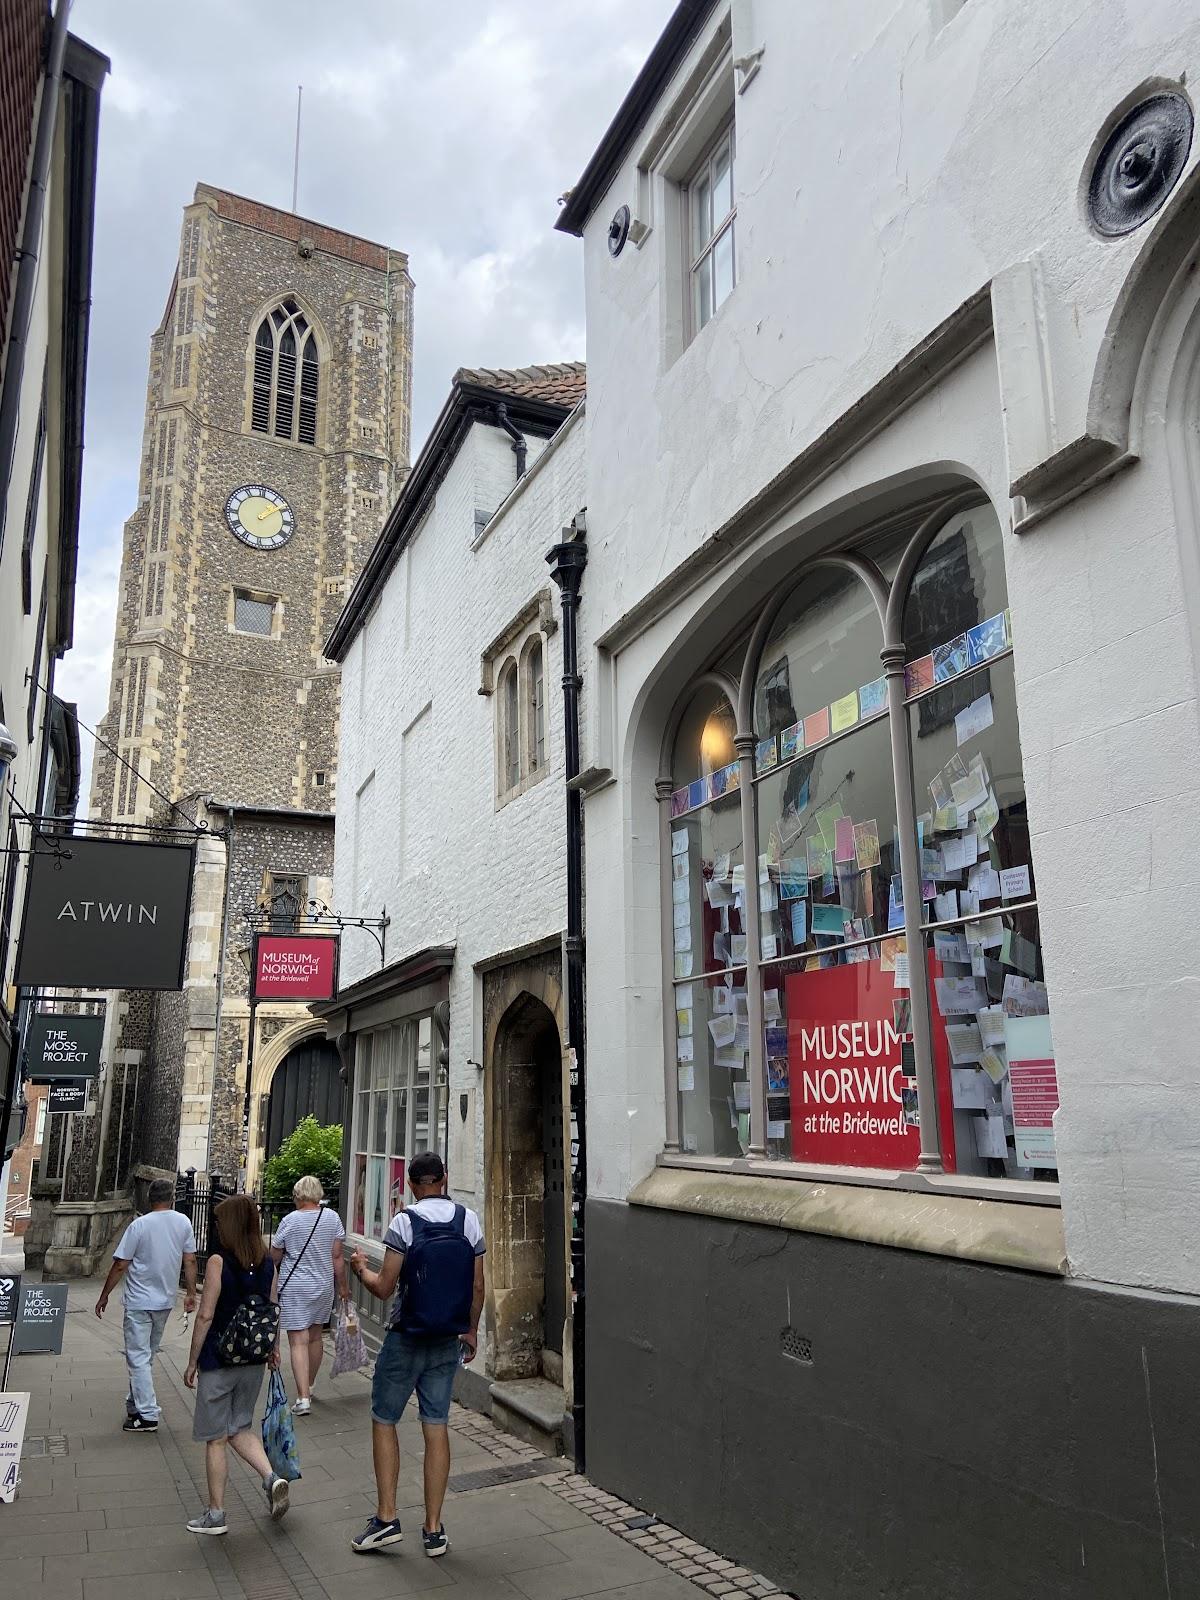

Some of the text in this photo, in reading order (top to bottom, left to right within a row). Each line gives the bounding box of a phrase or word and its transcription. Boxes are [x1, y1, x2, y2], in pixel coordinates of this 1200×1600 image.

[57, 901, 157, 924] ATWIN
[262, 952, 320, 966] MUSEUM of
[262, 964, 318, 975] NORWICH
[46, 1030, 67, 1040] THE
[44, 1041, 78, 1051] MOSS
[42, 1051, 89, 1062] PROJECT
[803, 1065, 909, 1104] NORWIC
[804, 1114, 817, 1133] at
[820, 1111, 840, 1133] the
[26, 1290, 44, 1298] THE
[24, 1299, 52, 1307] MOSS
[23, 1308, 60, 1316] PROJECT
[0, 1440, 18, 1449] zine
